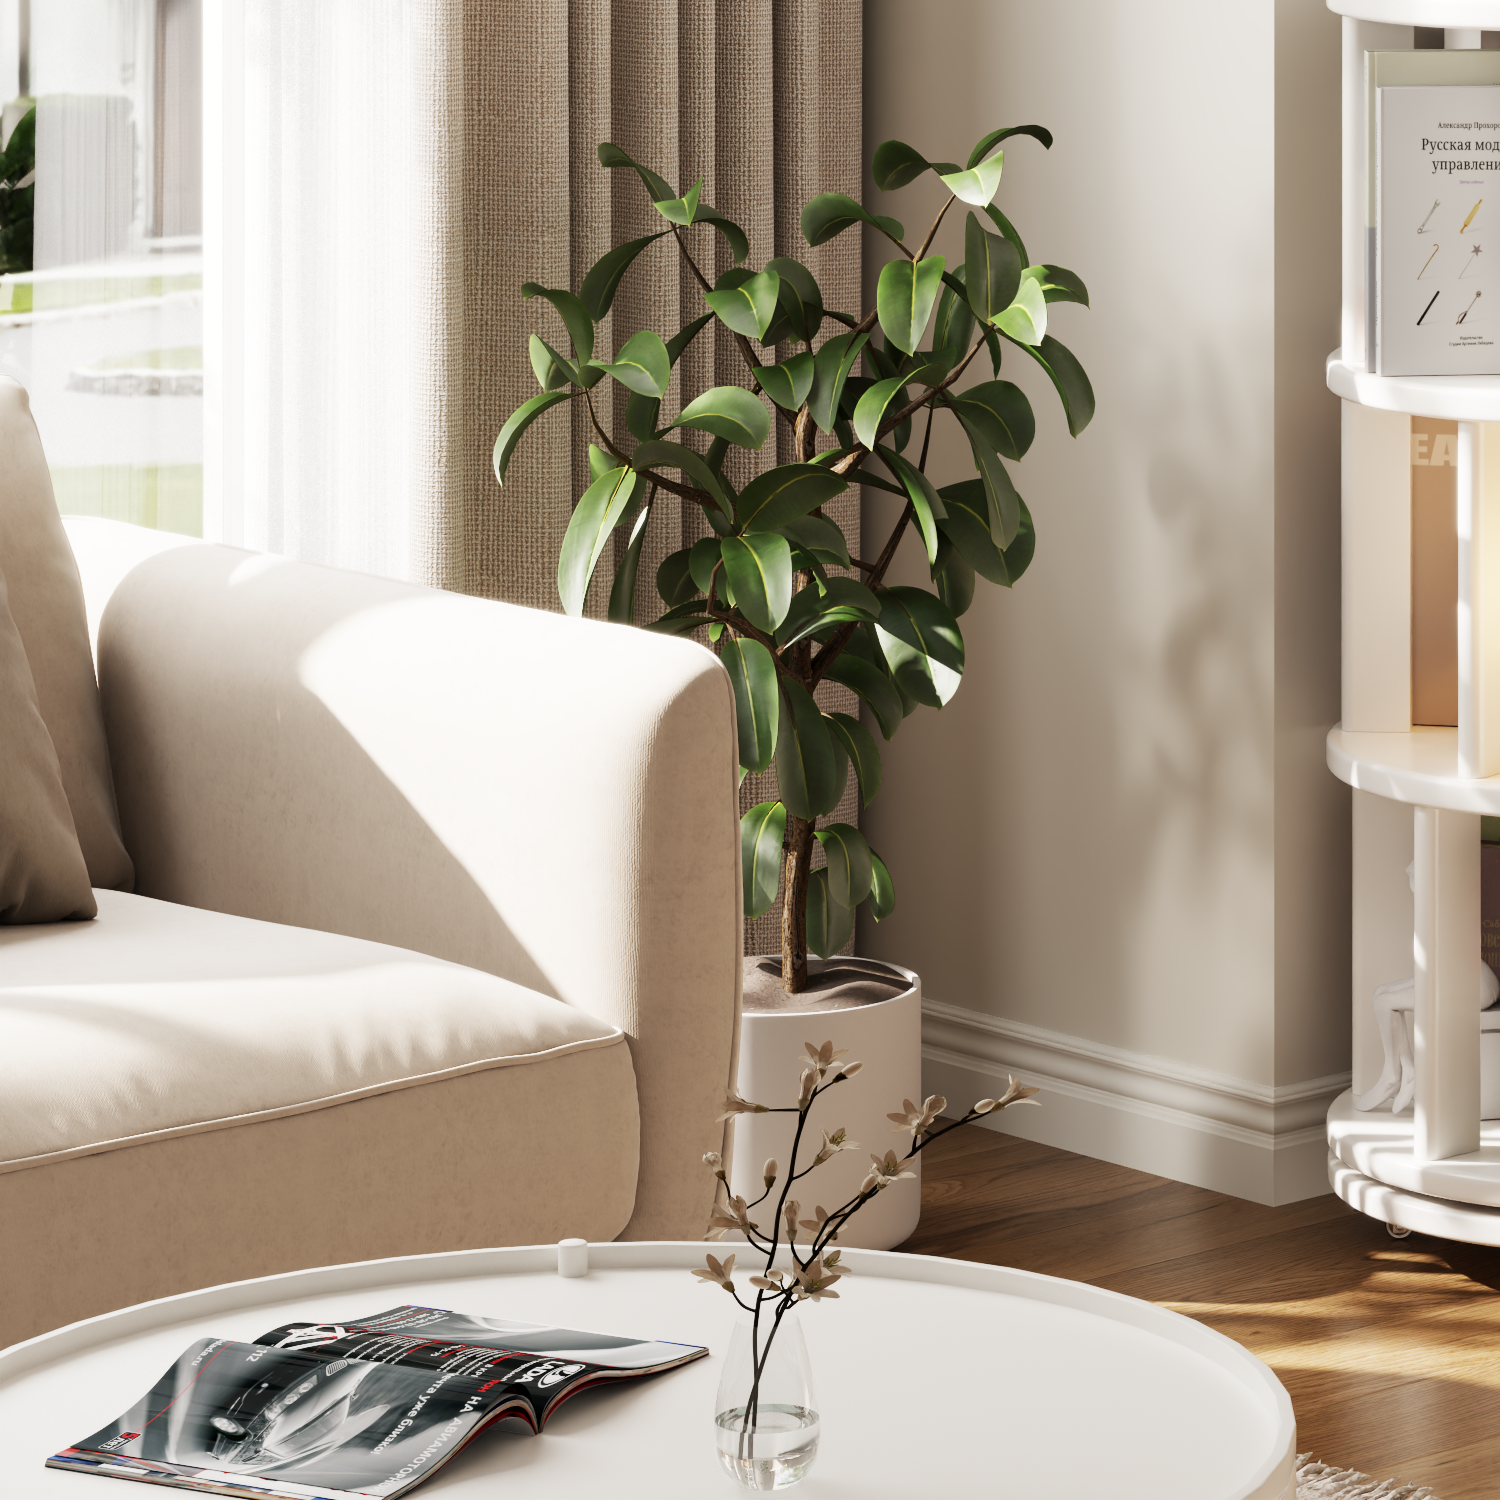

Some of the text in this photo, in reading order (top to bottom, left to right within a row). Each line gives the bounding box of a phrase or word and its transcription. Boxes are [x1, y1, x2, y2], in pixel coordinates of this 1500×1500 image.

[1437, 121, 1473, 131] Александр
[1421, 137, 1471, 155] Русская
[513, 1360, 565, 1384] LADA
[459, 1395, 483, 1414] НА
[369, 1394, 432, 1456] уже близко!
